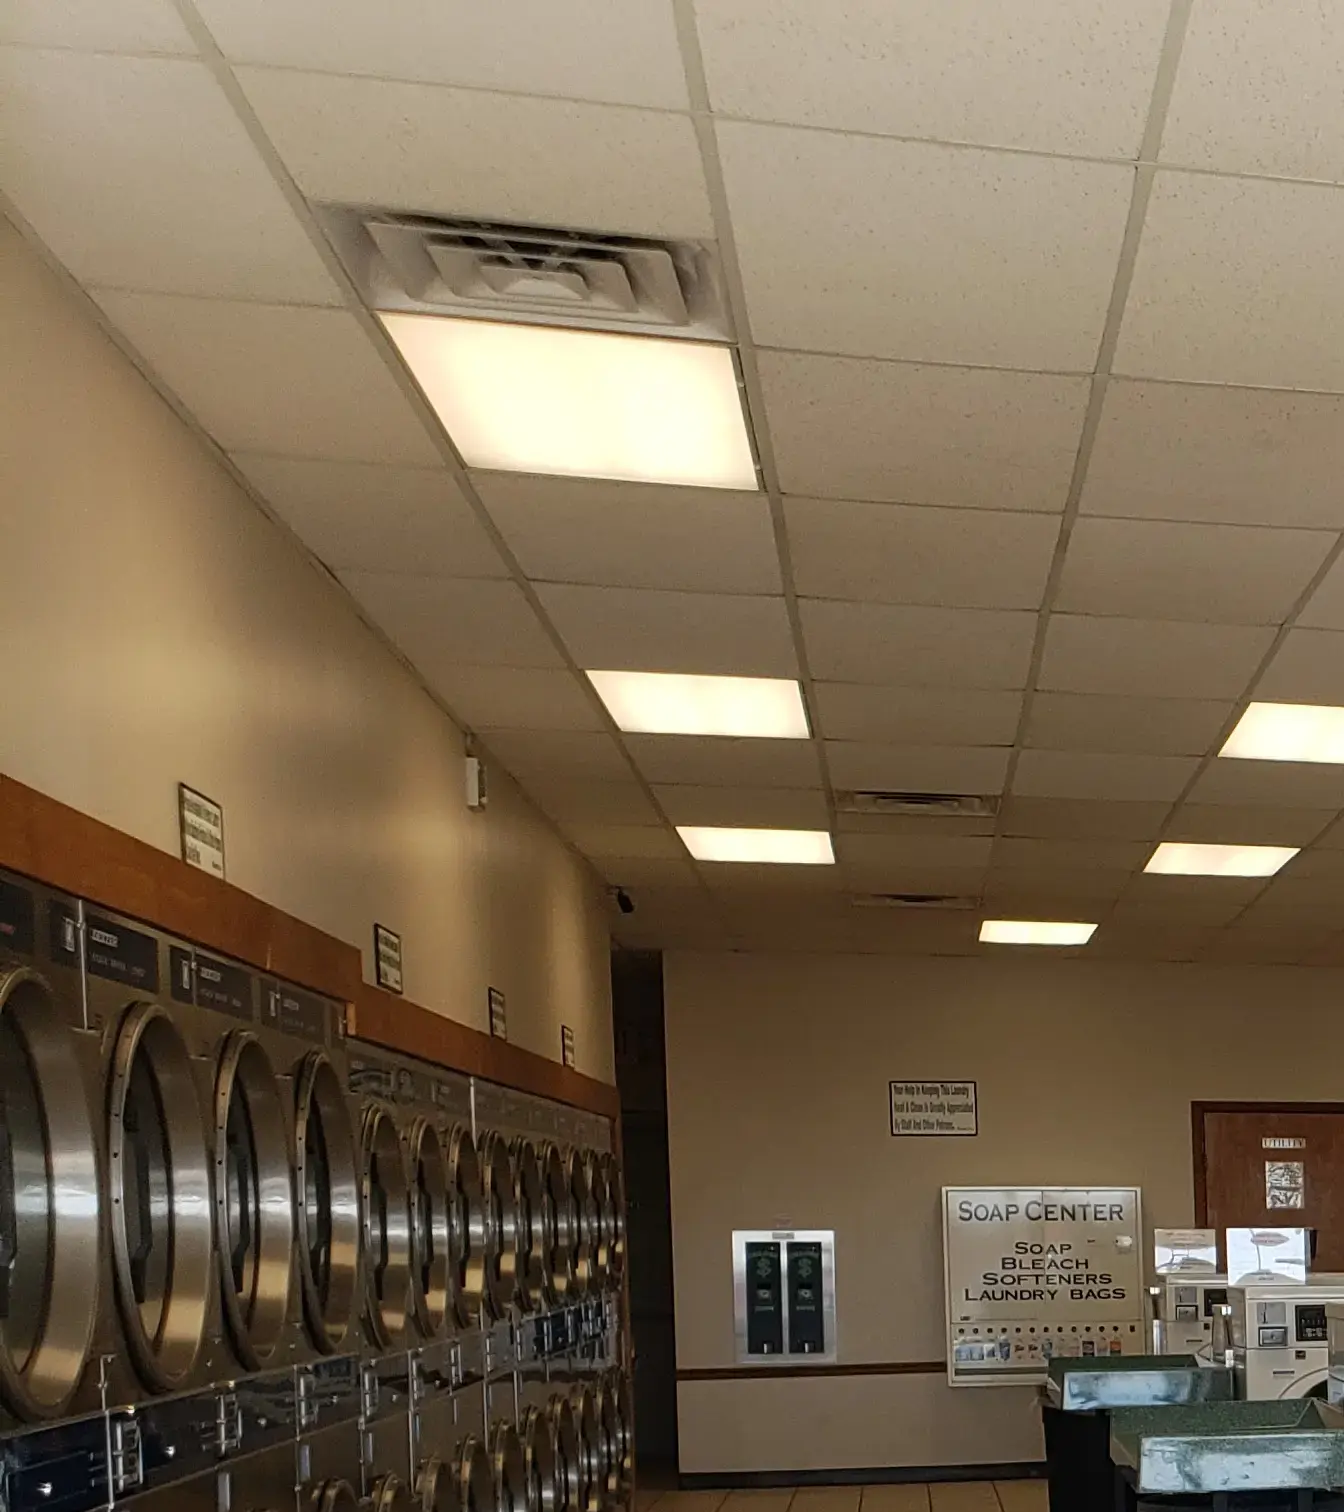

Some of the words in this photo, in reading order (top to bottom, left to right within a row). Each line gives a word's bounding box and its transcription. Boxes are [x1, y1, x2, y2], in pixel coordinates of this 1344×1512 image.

[958, 1200, 1019, 1222] SOAP
[1025, 1200, 1124, 1222] CENTER
[1015, 1242, 1072, 1255] SOAP
[1001, 1257, 1089, 1270] BLEACH
[982, 1272, 1112, 1286] SOFTENERS
[964, 1288, 1058, 1301] LAUNDRY
[1070, 1288, 1126, 1300] BAGS
